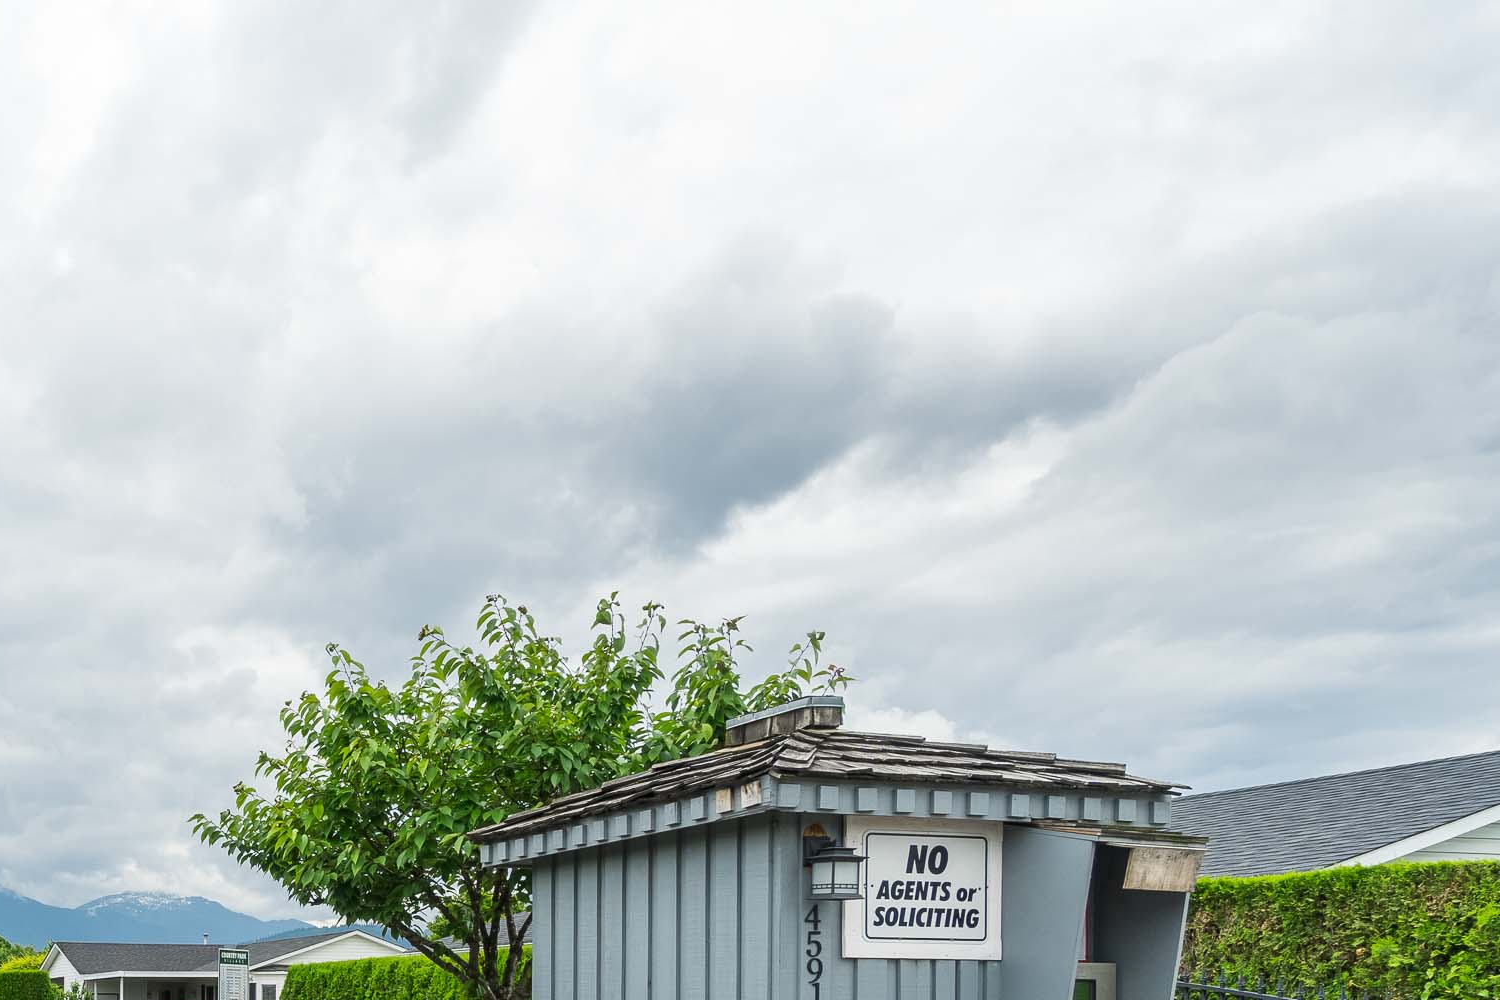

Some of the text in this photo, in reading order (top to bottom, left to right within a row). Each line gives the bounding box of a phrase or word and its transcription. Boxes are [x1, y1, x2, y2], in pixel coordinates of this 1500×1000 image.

[906, 844, 948, 875] NO
[876, 880, 977, 902] AGENTS or
[873, 906, 980, 929] SOLICITING
